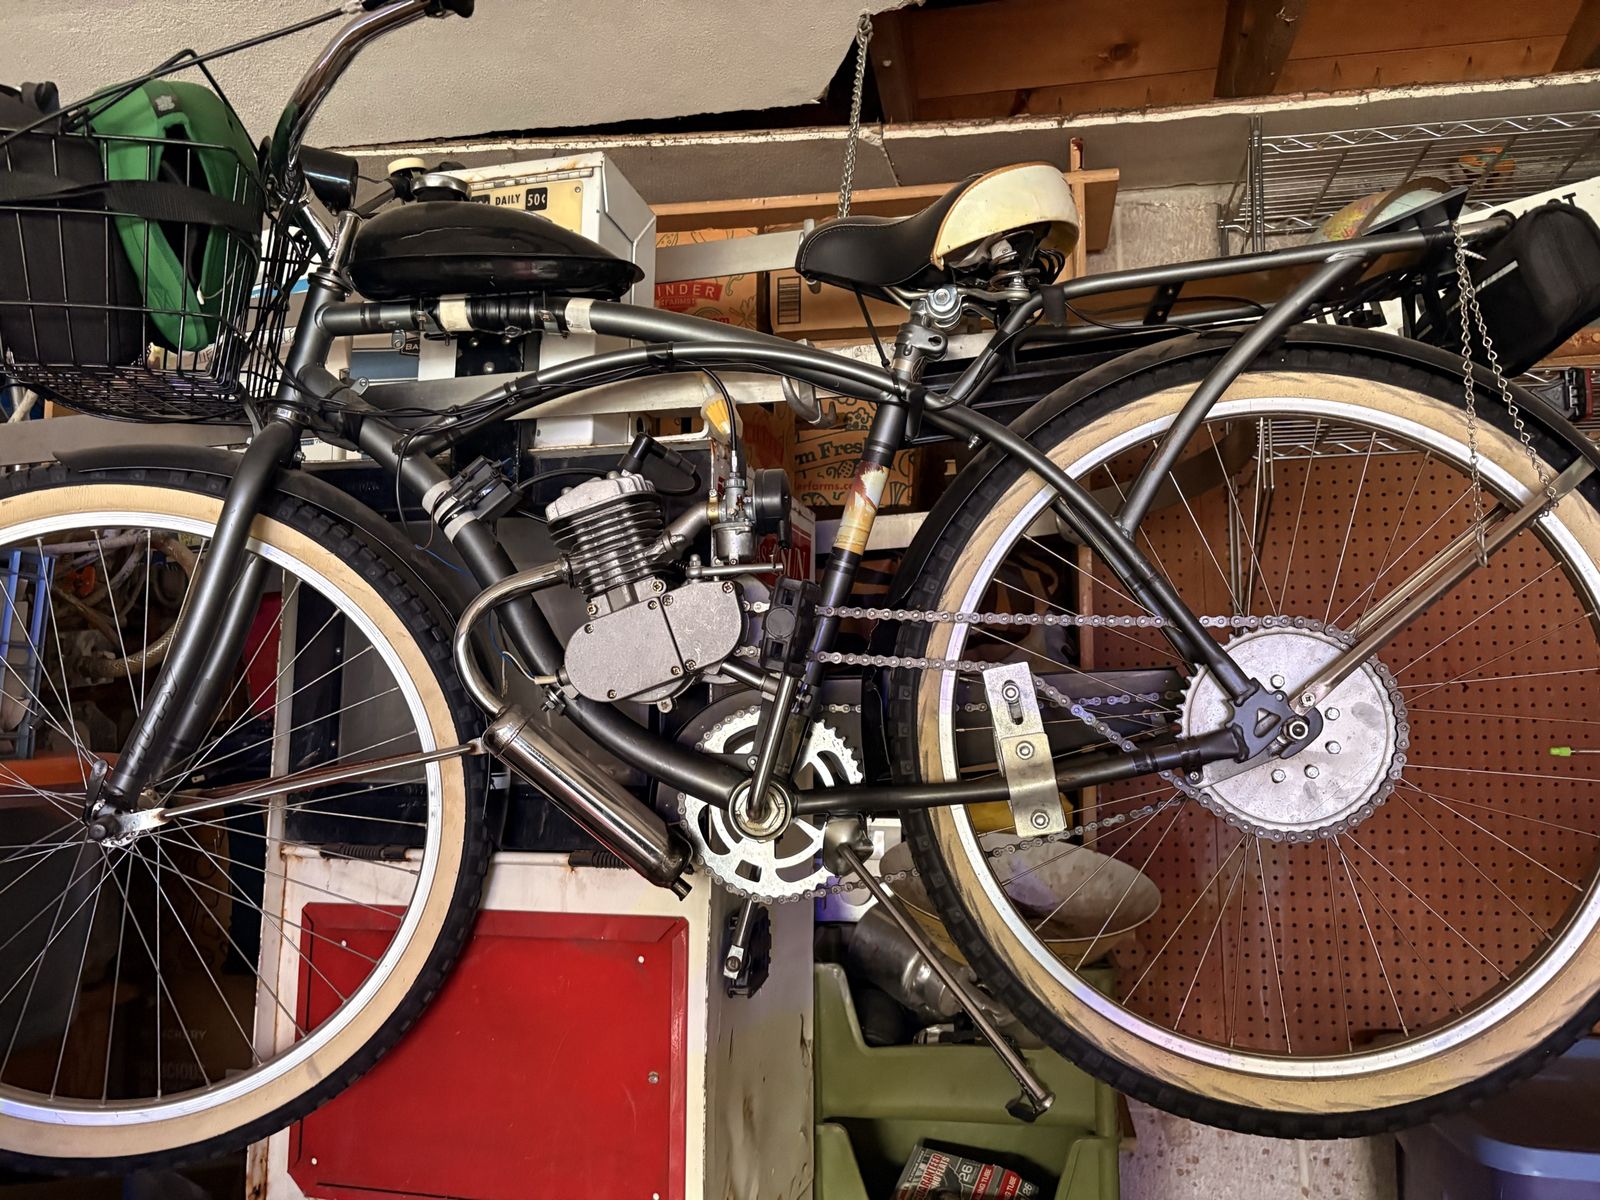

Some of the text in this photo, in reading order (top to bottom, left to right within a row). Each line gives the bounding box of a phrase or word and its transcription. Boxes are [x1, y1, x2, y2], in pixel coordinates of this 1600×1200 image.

[495, 193, 521, 206] DAILY
[527, 192, 546, 207] 50¢
[656, 283, 716, 298] INDER
[818, 436, 867, 459] Fres
[126, 665, 178, 776] HUFFY
[934, 1155, 951, 1177] FLATS
[959, 1164, 974, 1182] 26
[981, 1167, 993, 1184] TUBE
[1006, 1175, 1018, 1192] TUBE
[1022, 1182, 1034, 1196] 26
